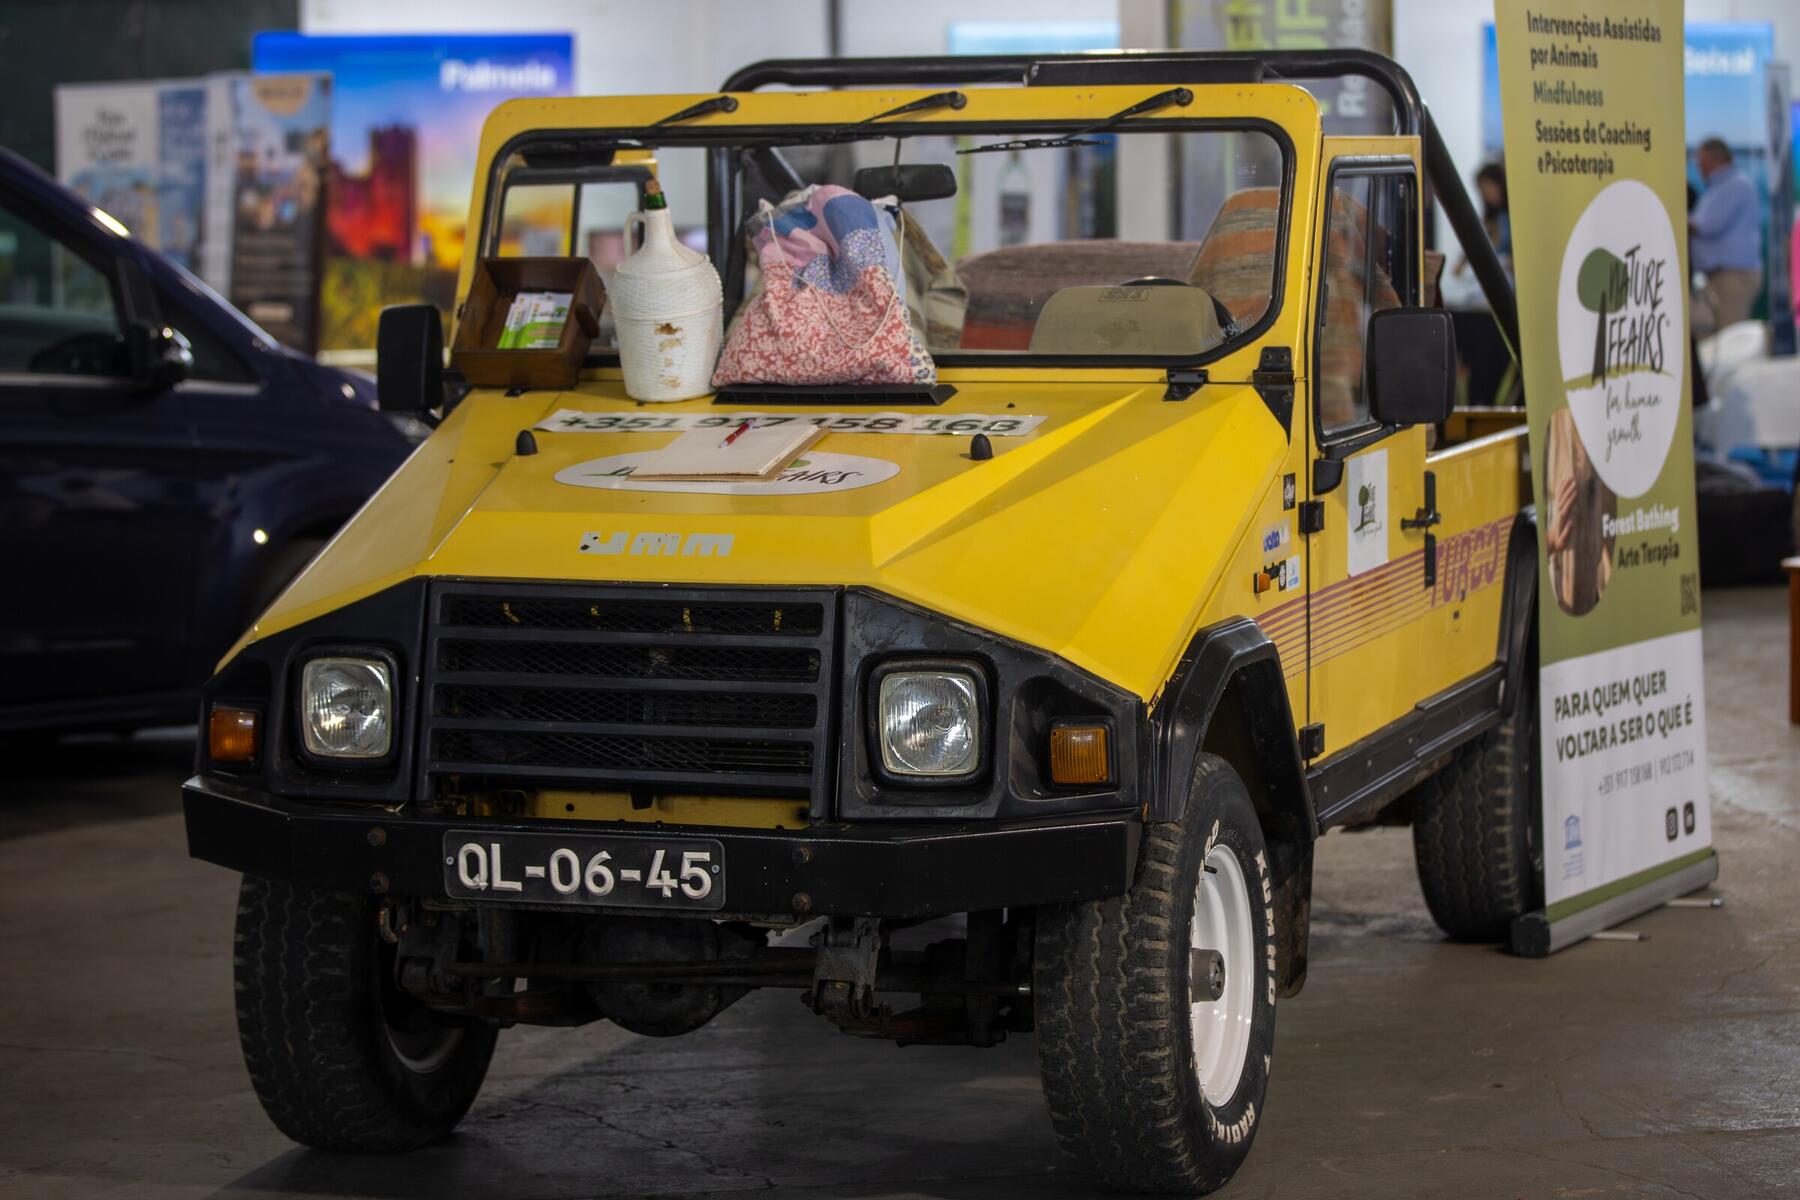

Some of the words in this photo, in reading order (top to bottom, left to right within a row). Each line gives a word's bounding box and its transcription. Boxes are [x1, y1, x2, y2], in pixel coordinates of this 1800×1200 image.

[1527, 10, 1600, 42] Intervenções
[1603, 16, 1662, 42] Assistidas
[1530, 47, 1548, 70] por
[1550, 44, 1598, 68] Animais
[1533, 80, 1604, 107] Mindfulness
[1535, 118, 1581, 143] Sessões
[1583, 119, 1597, 144] de
[1598, 121, 1652, 152] Coaching
[1537, 156, 1544, 174] e
[1544, 151, 1614, 180] Psicoterapia
[560, 415, 682, 430] +351
[1602, 512, 1636, 538] Forest
[1636, 502, 1680, 534] Bathing
[1618, 547, 1640, 569] Arte
[1641, 537, 1680, 567] Terapia
[1554, 688, 1591, 722] PARA
[1592, 679, 1631, 717] QUEM
[1632, 670, 1667, 706] QUER
[1556, 726, 1607, 763] VOLTAR
[1609, 723, 1618, 747] A
[1619, 715, 1643, 744] SER
[1645, 712, 1655, 735] O
[1658, 704, 1682, 739] QUE
[1685, 694, 1693, 725] É
[457, 842, 713, 900] QL-06-45
[1254, 849, 1277, 1007] KUMHO
